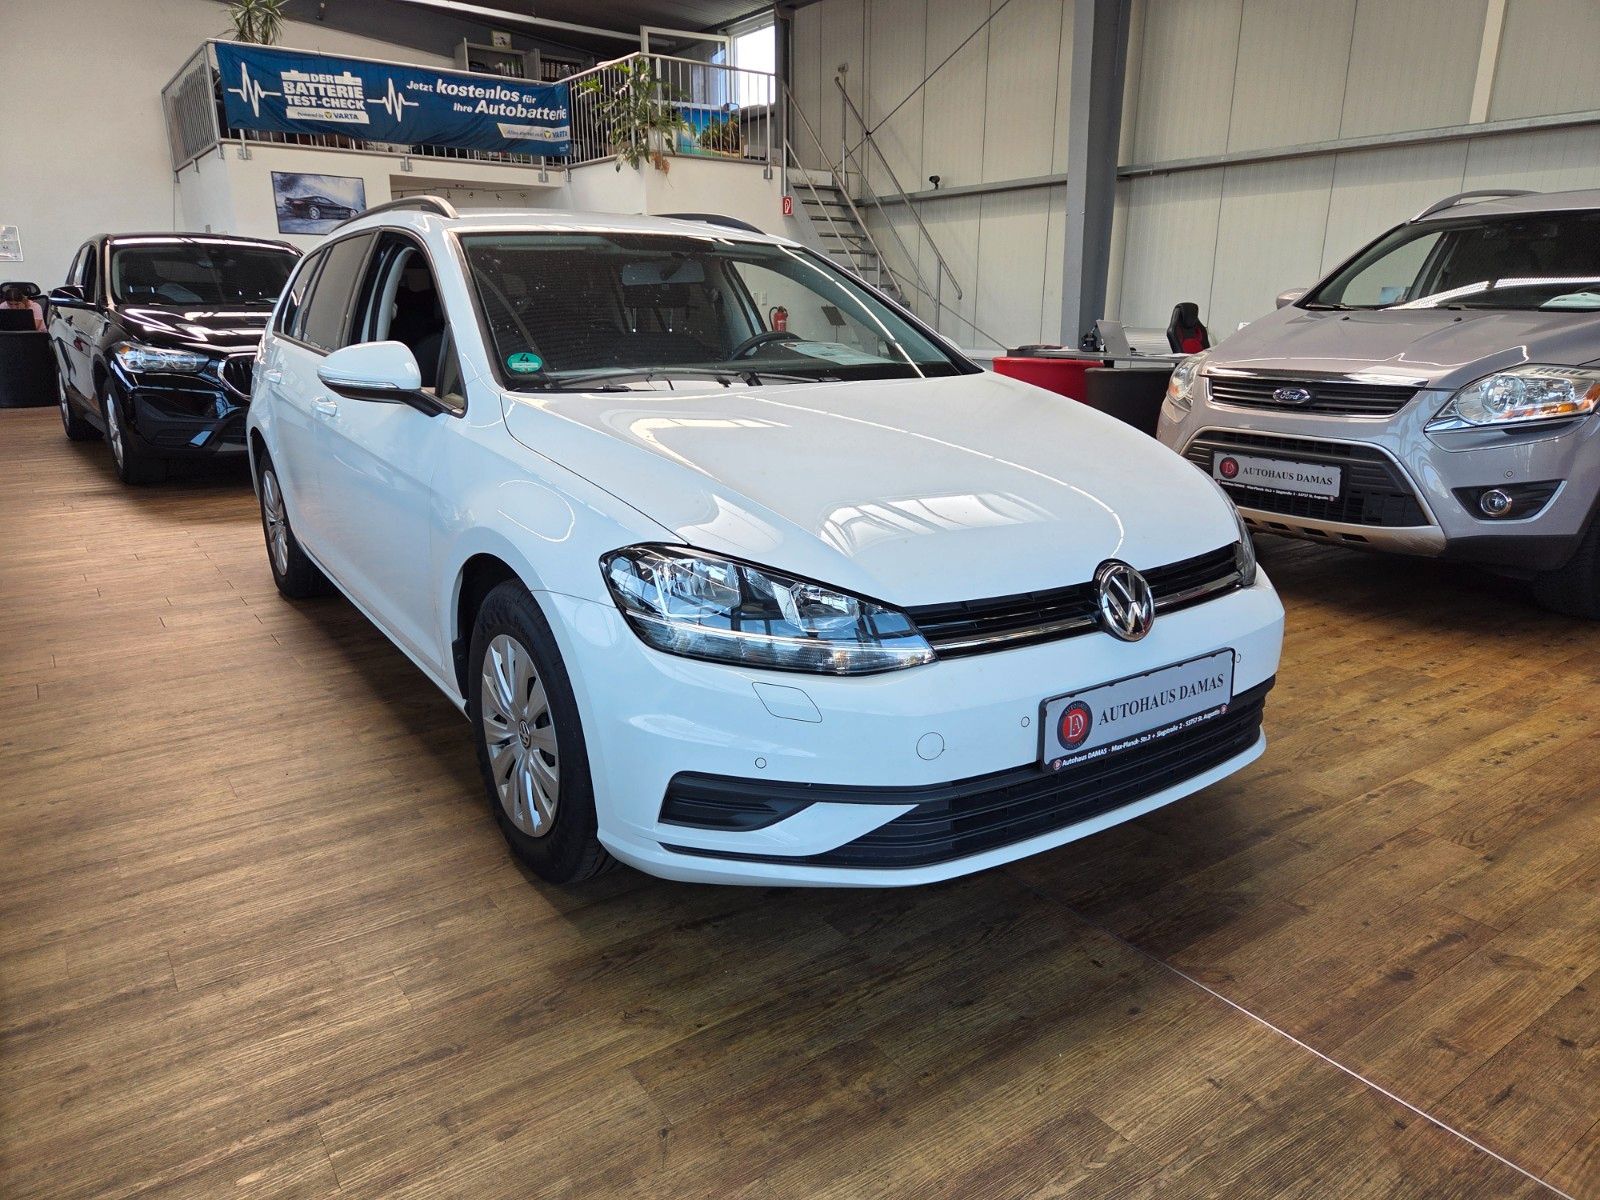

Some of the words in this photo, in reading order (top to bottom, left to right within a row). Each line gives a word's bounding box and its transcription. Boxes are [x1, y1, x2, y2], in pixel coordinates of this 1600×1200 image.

[310, 74, 335, 84] DER
[282, 81, 364, 99] BATTERIE
[406, 80, 433, 93] Jetzt
[436, 78, 520, 102] kostenlos
[522, 94, 537, 104] für
[285, 95, 366, 111] TEST-CHECK
[453, 102, 473, 113] Ihre
[475, 99, 567, 121] Autobatterie
[333, 112, 359, 120] VARTA
[520, 354, 530, 363] 4
[1242, 467, 1294, 481] AUTOHAUS
[1296, 473, 1333, 486] DAMAS
[1098, 688, 1176, 726] AUTOHAUS
[1178, 673, 1225, 701] DAMAS
[1062, 754, 1087, 766] Autohaus
[1087, 747, 1108, 759] DAMAS
